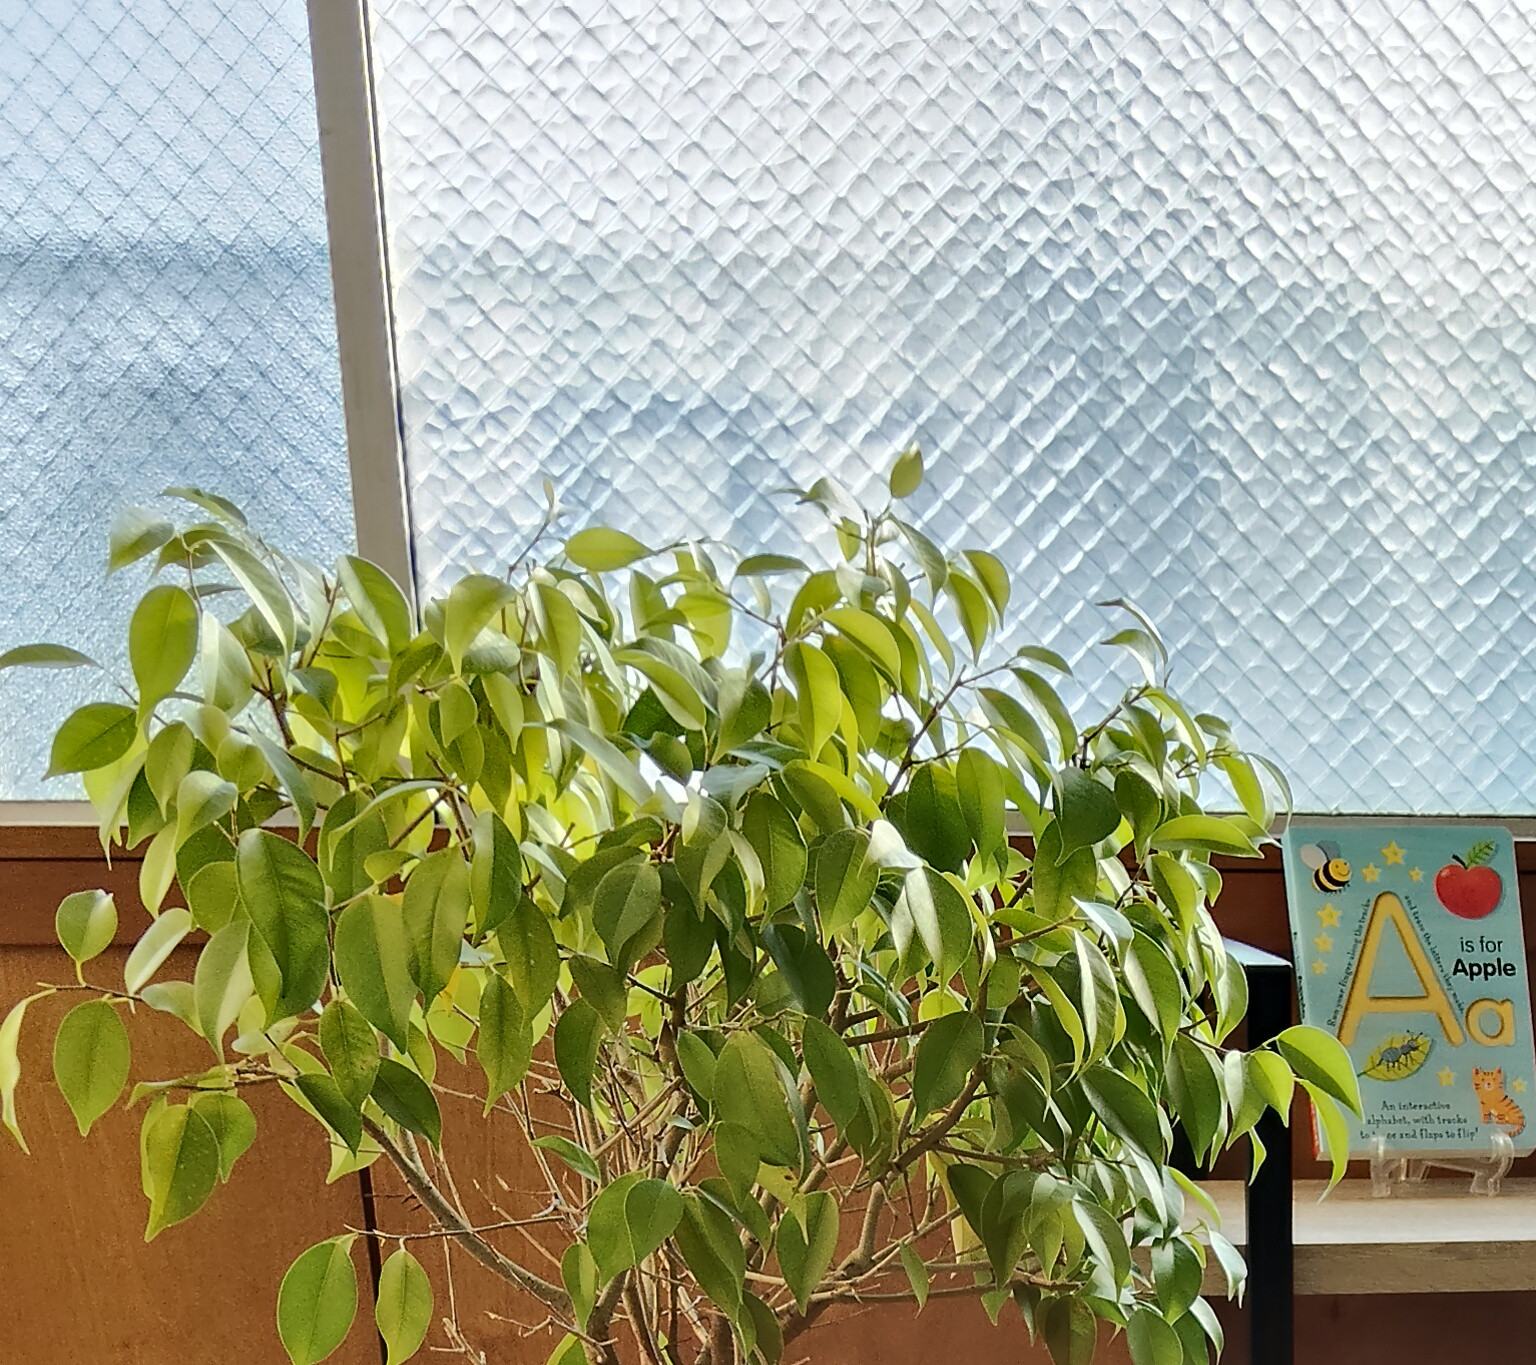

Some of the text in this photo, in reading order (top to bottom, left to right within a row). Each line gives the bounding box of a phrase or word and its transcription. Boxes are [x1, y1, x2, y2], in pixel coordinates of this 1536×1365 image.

[1460, 936, 1504, 953] is for
[1452, 958, 1517, 980] Apple
[1381, 1100, 1451, 1111] An interactive
[1367, 1114, 1468, 1128] alphabet, with tracks
[1360, 1130, 1370, 1139] to
[1400, 1129, 1417, 1139] and
[1420, 1128, 1443, 1142] flaps
[1445, 1130, 1456, 1139] to
